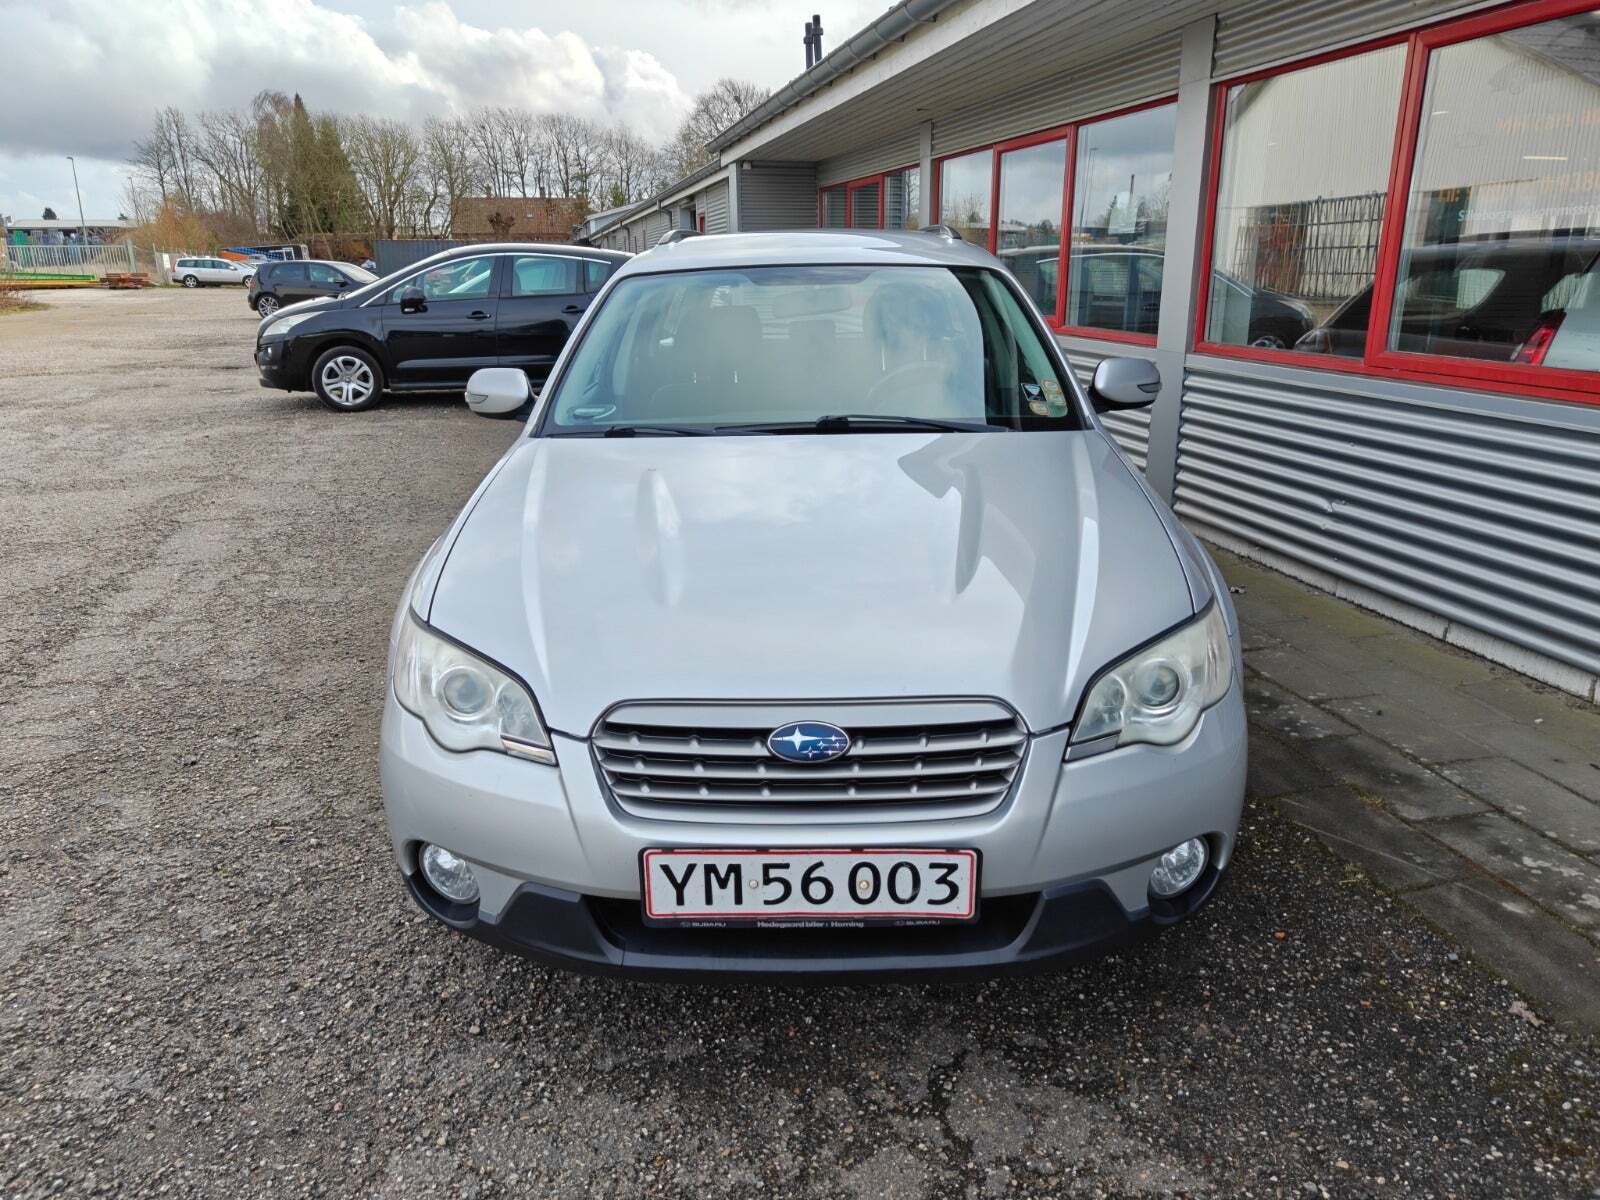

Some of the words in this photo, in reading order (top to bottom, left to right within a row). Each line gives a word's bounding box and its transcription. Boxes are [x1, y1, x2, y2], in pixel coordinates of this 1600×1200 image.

[659, 863, 743, 906] YM
[762, 861, 834, 905] 56
[848, 861, 960, 905] 003
